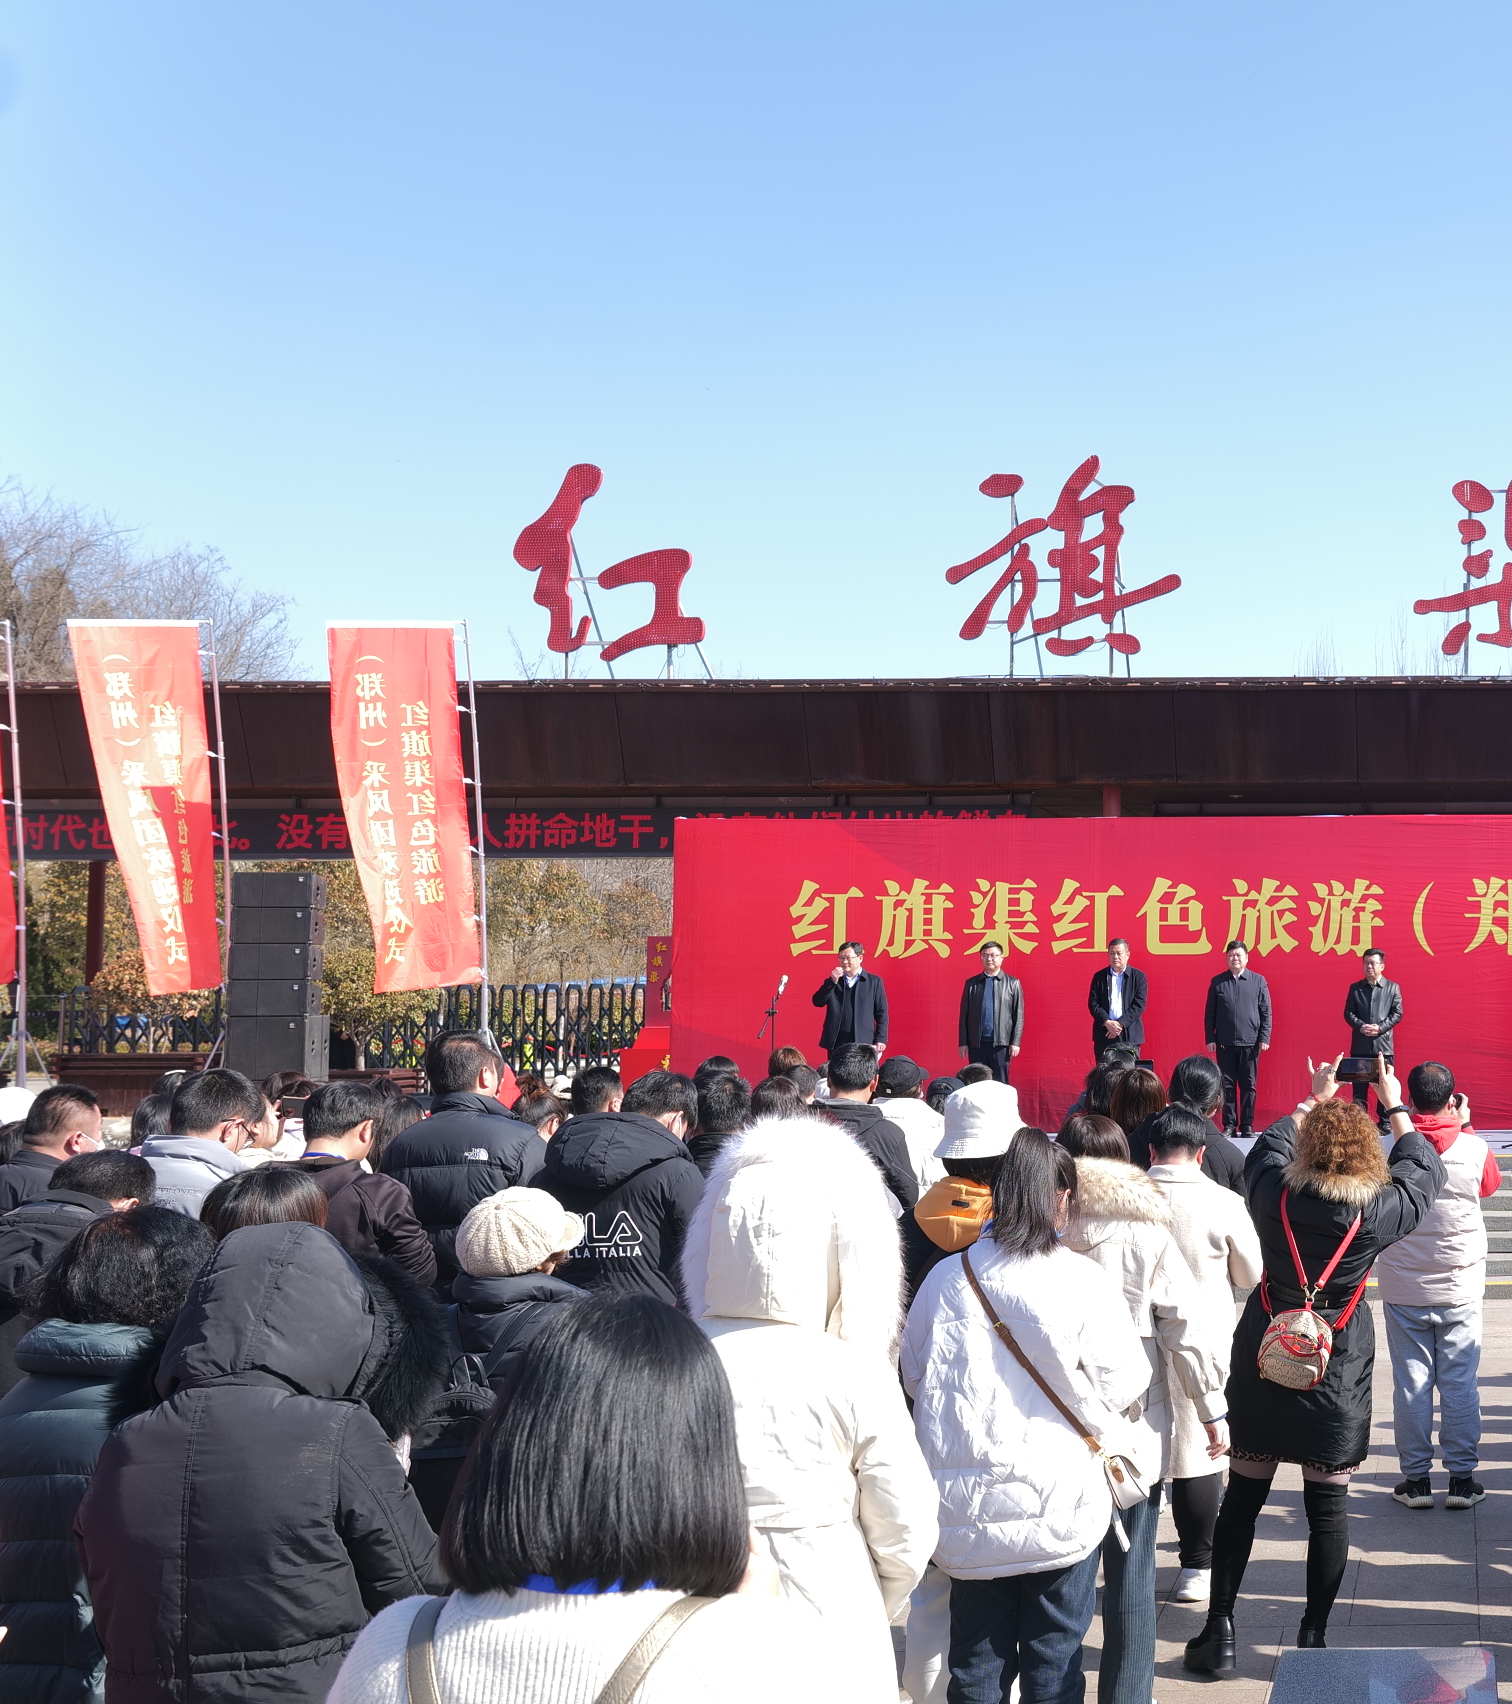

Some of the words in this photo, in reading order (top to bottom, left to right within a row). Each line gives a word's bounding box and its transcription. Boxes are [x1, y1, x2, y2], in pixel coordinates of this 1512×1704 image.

[648, 941, 667, 983] 红旗渠
[577, 1211, 643, 1246] LA
[595, 1245, 642, 1258] ITALIA
